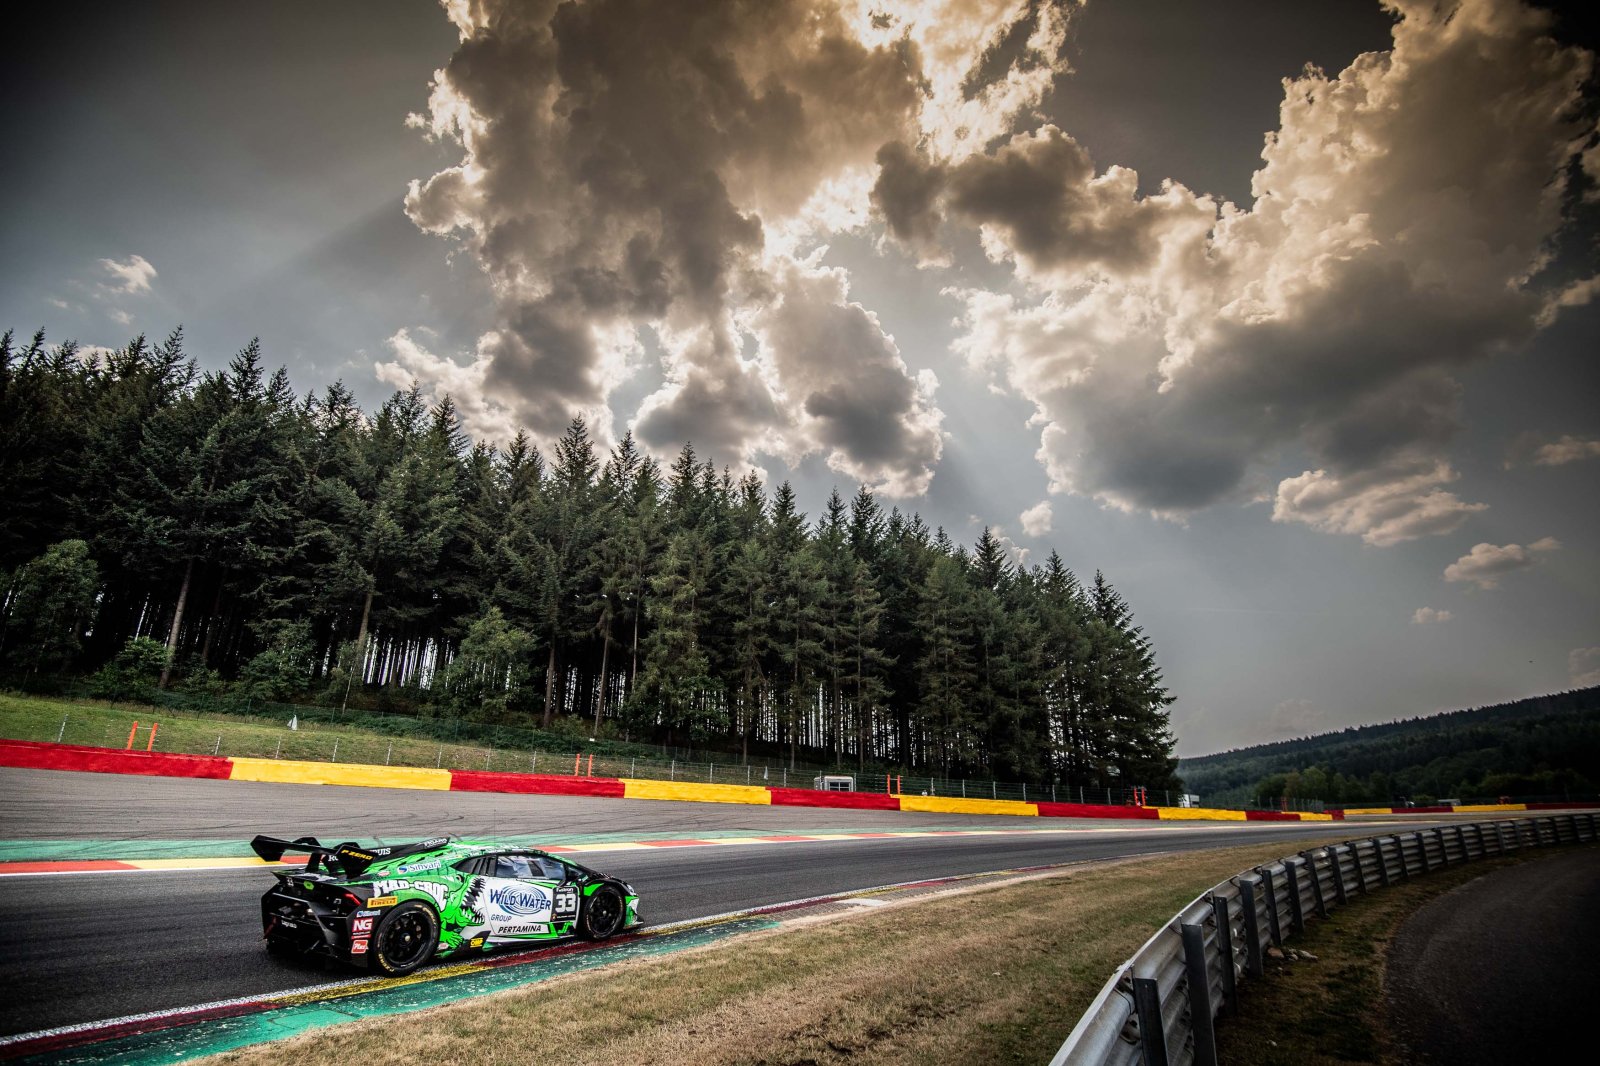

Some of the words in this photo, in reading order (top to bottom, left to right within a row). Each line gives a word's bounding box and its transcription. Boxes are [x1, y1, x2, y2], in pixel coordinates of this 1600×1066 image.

[490, 889, 516, 905] WILD
[520, 892, 551, 910] WATER
[555, 893, 576, 913] 33
[490, 914, 512, 922] GROUP
[353, 919, 373, 931] NG
[498, 925, 541, 933] PERTAMINA
